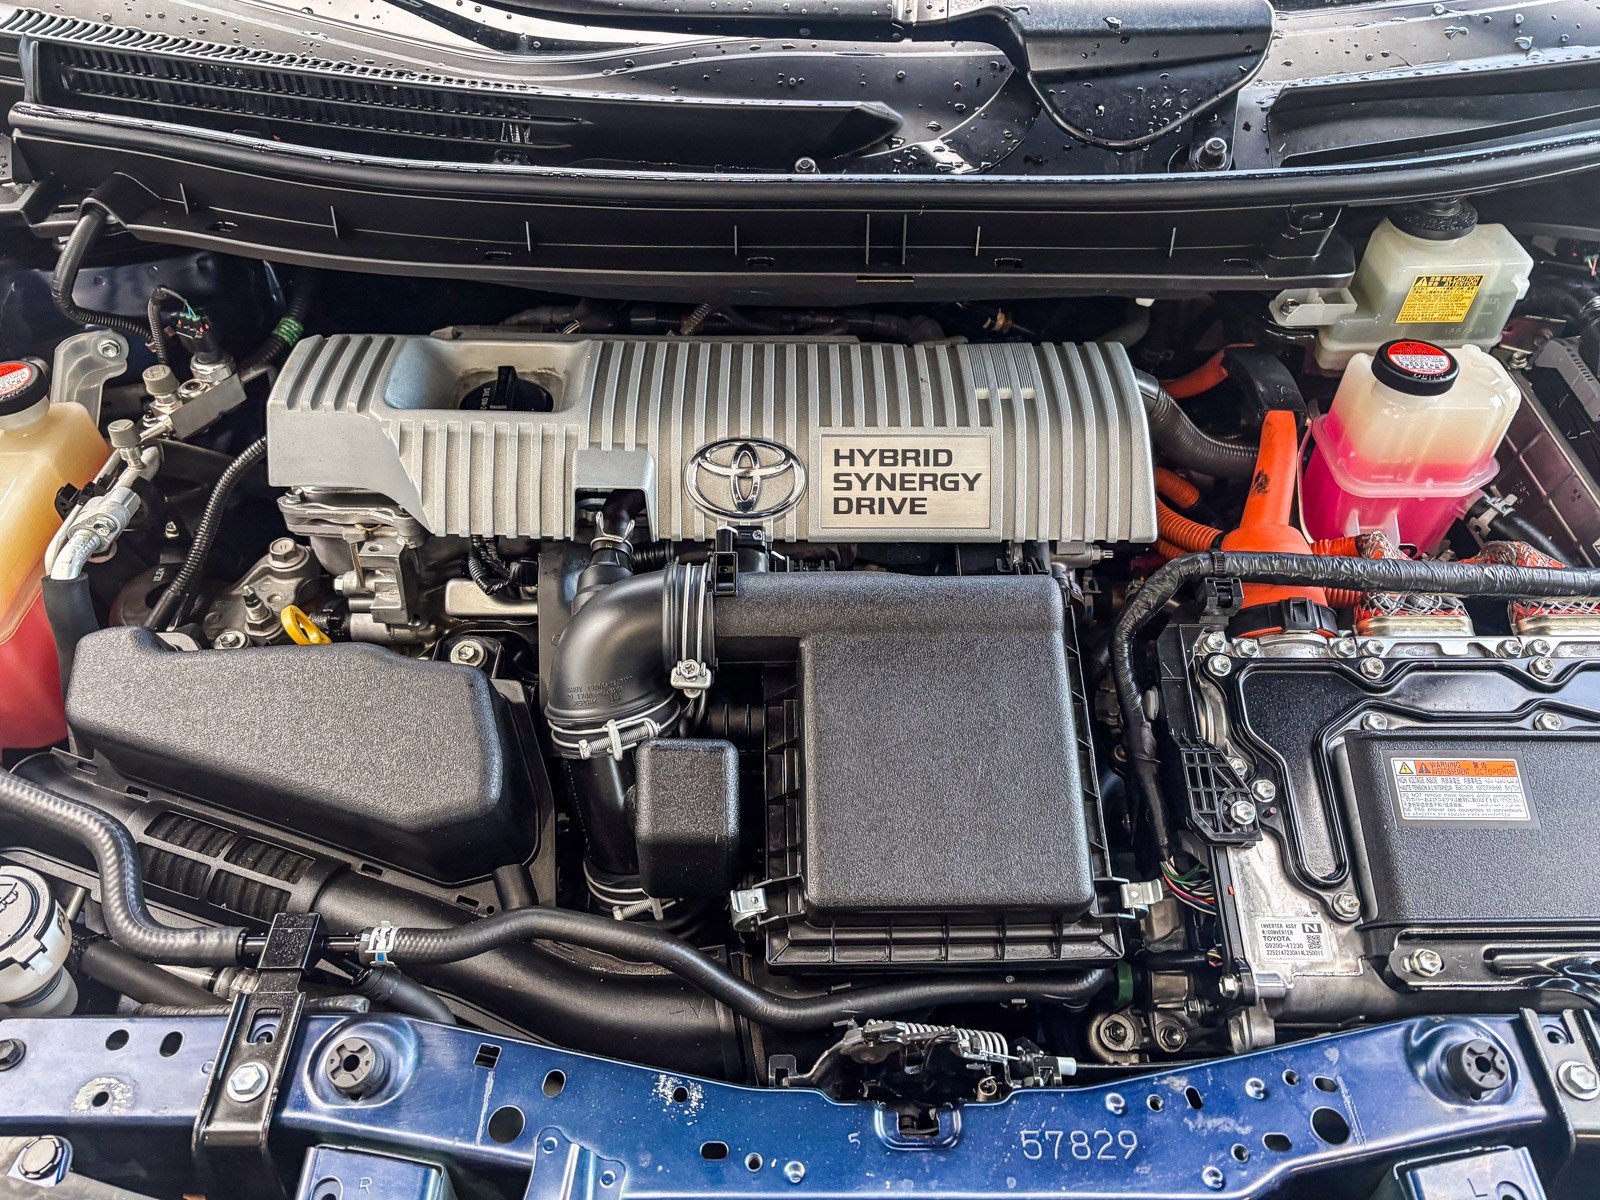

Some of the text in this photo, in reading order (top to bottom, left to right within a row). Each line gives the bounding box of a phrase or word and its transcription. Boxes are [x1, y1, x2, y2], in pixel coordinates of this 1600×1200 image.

[834, 449, 953, 467] HYBRID
[833, 472, 982, 491] SYNERGY
[833, 497, 928, 515] DRIVE
[1431, 761, 1461, 769] WARNING
[848, 1132, 861, 1149] 5
[1020, 1130, 1139, 1160] 57829
[358, 1176, 373, 1196] R
[1466, 1177, 1488, 1198] L
